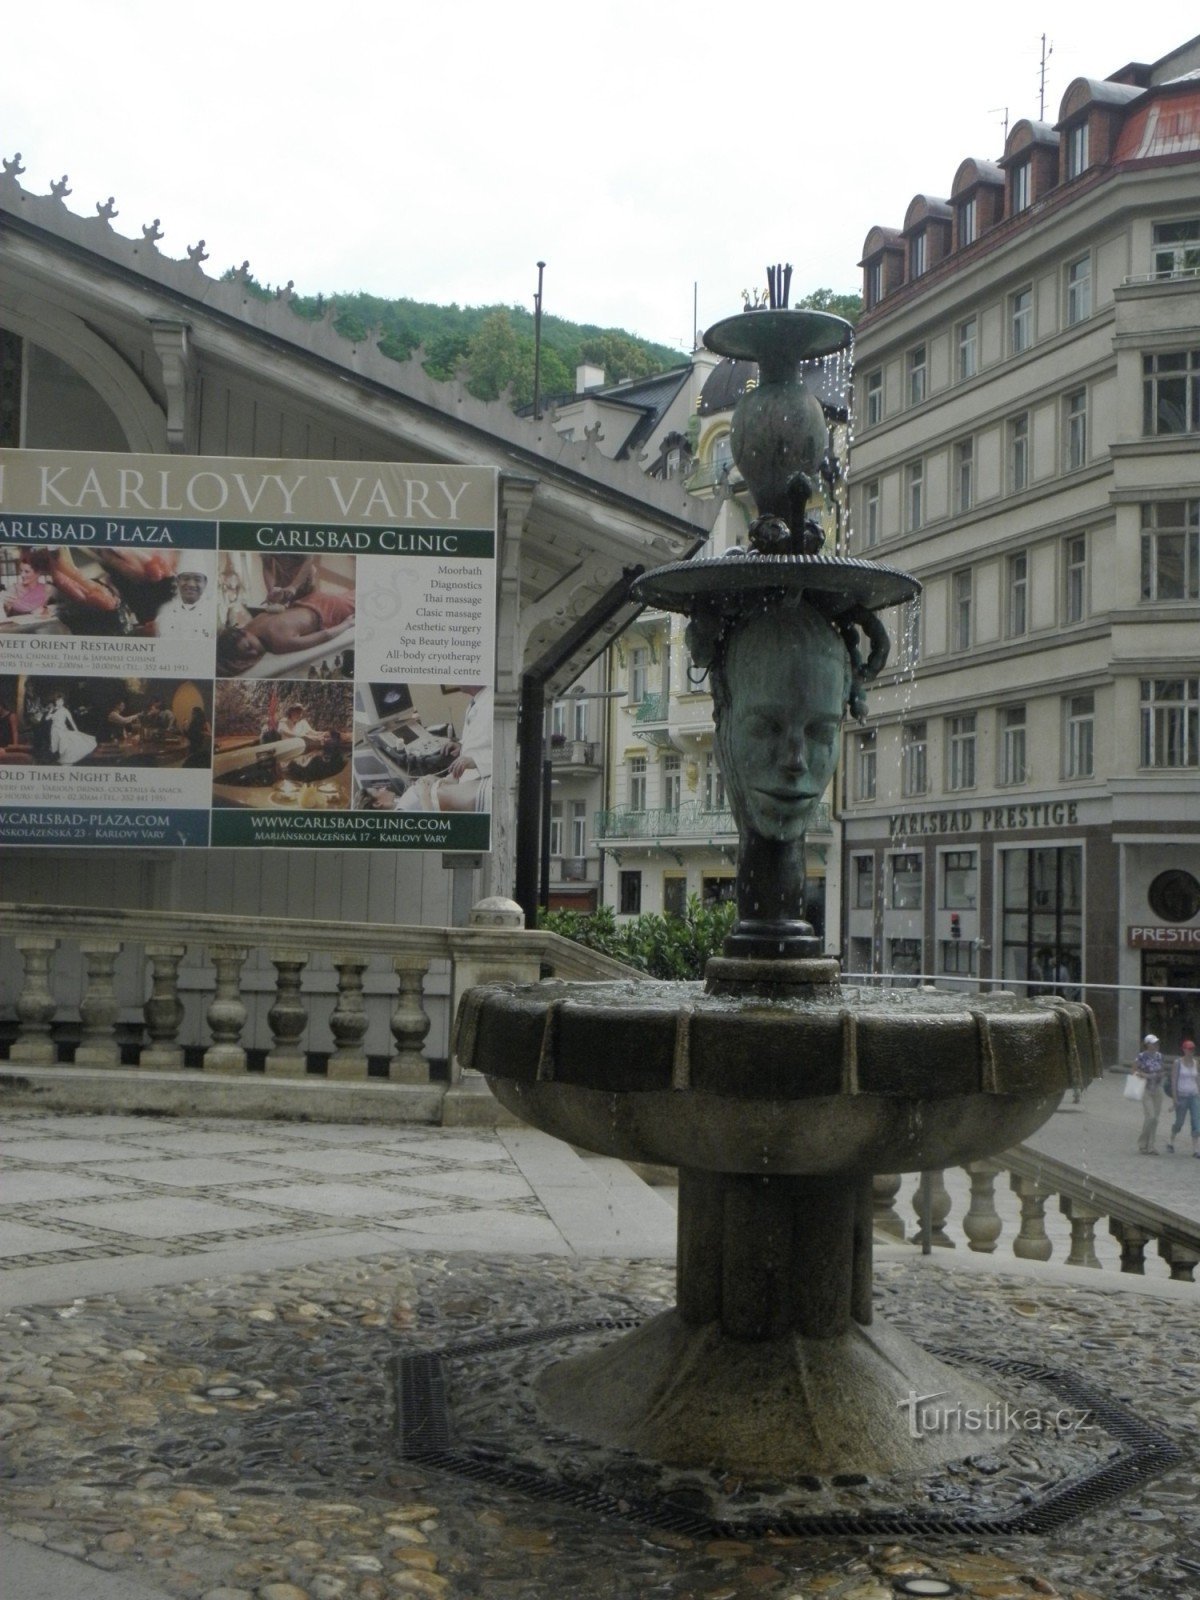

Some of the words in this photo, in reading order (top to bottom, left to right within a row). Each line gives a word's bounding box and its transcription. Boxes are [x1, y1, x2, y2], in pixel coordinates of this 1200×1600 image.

[38, 466, 307, 514] KARLOVY
[326, 475, 472, 520] VARY
[106, 522, 173, 543] PLAZA
[256, 527, 370, 549] CARLSBAD
[379, 531, 458, 552] CLINIC
[438, 565, 482, 576] Moorbath
[430, 580, 482, 591] Diagnostics
[424, 593, 443, 603] Thai
[445, 596, 482, 606] massage
[416, 607, 442, 617] Clasic
[445, 610, 482, 620] massage
[405, 622, 446, 632] Aesthetic
[448, 625, 482, 635] surgery
[30, 639, 77, 650] ORIENT
[80, 640, 156, 652] RESTAURANT
[400, 636, 416, 647] Spa
[419, 637, 449, 648] Beauty
[451, 637, 481, 649] lounge
[386, 650, 426, 662] All-body
[428, 652, 481, 664] cryotherapy
[380, 664, 451, 675] Gastrointestinal
[453, 666, 481, 676] centre
[0, 770, 25, 780] OLD
[29, 771, 65, 781] TIMES
[70, 771, 110, 782] NIGHT
[115, 772, 137, 782] BAR
[982, 802, 1079, 830] PRESTIGE
[251, 816, 451, 830] WWW.CARLSBADCLINIC.COM
[74, 829, 86, 838] 23
[95, 829, 139, 838] KARLOVY
[141, 829, 166, 839] VARY
[360, 832, 370, 842] 17
[380, 833, 421, 843] KARLOVY
[423, 833, 447, 843] VARY
